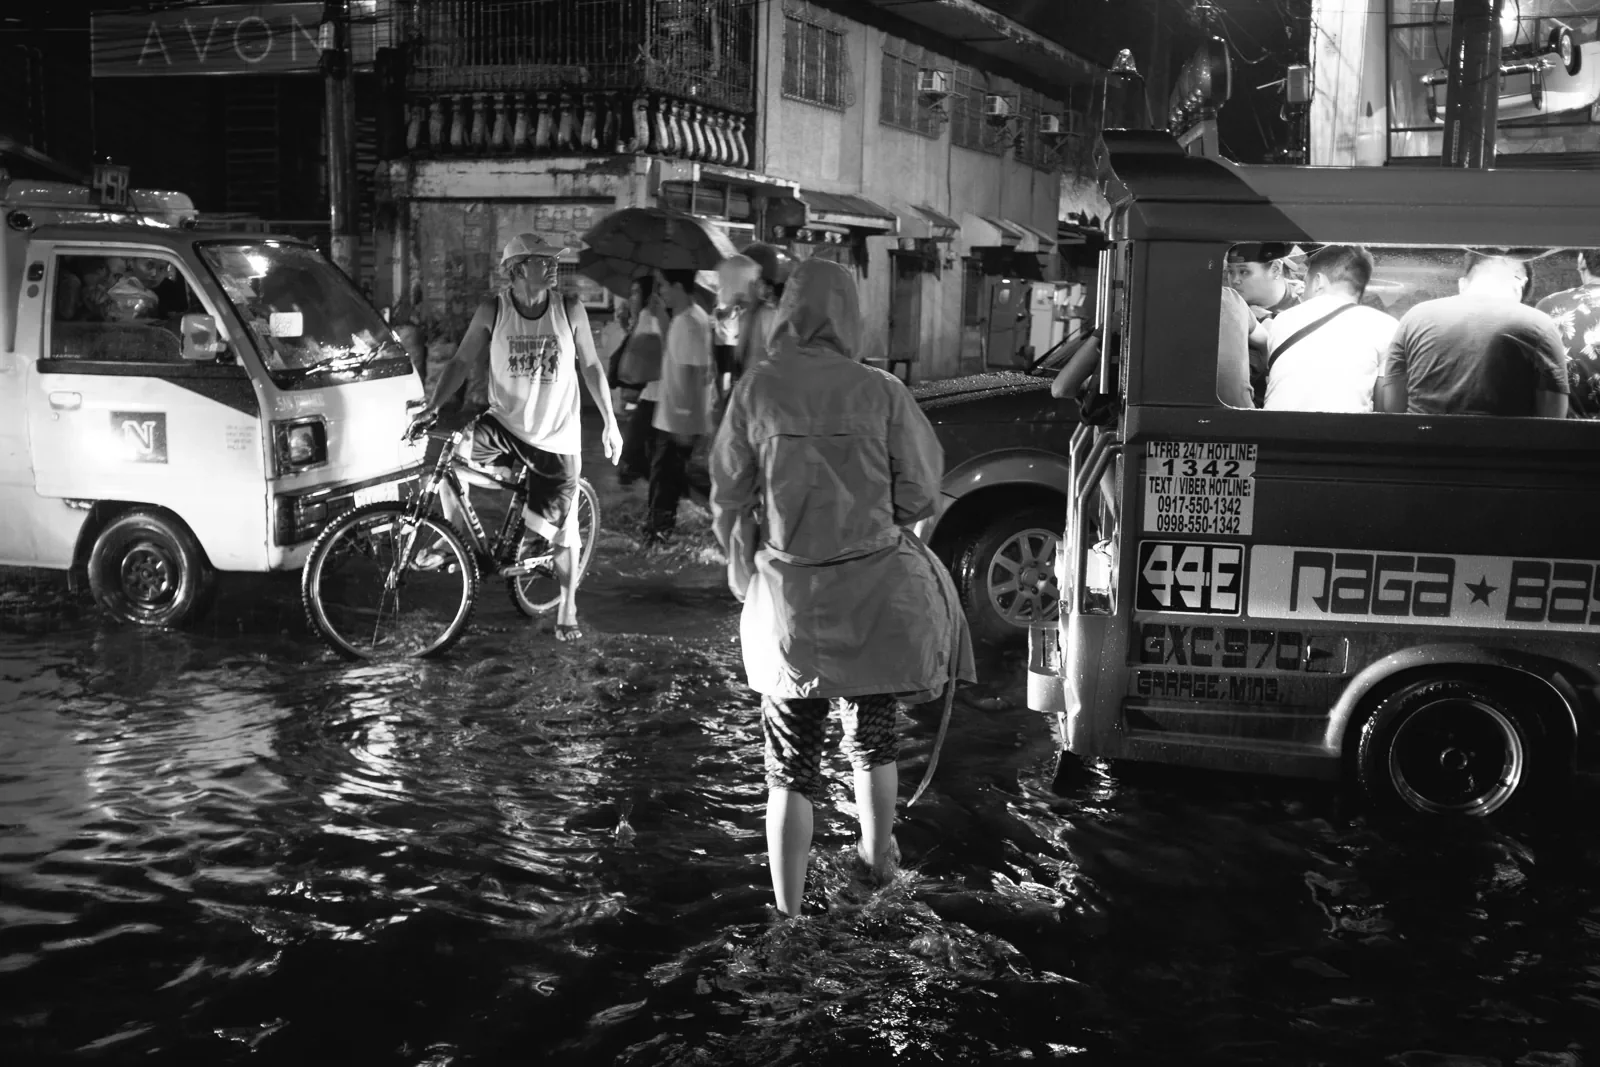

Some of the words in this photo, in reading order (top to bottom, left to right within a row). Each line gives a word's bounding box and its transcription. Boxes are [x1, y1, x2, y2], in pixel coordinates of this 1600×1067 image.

[137, 14, 323, 65] AVON
[1147, 442, 1180, 459] LTFRB
[1183, 443, 1204, 460] 24/7
[1207, 444, 1256, 461] HOTLINE:
[1162, 459, 1240, 478] 1342
[1149, 476, 1173, 494] TEXT
[1179, 477, 1206, 496] VIBER
[1209, 478, 1251, 497] HOTLINE:
[1158, 495, 1241, 515] 0917-550-1342
[1157, 514, 1240, 534] 0998-550-1342
